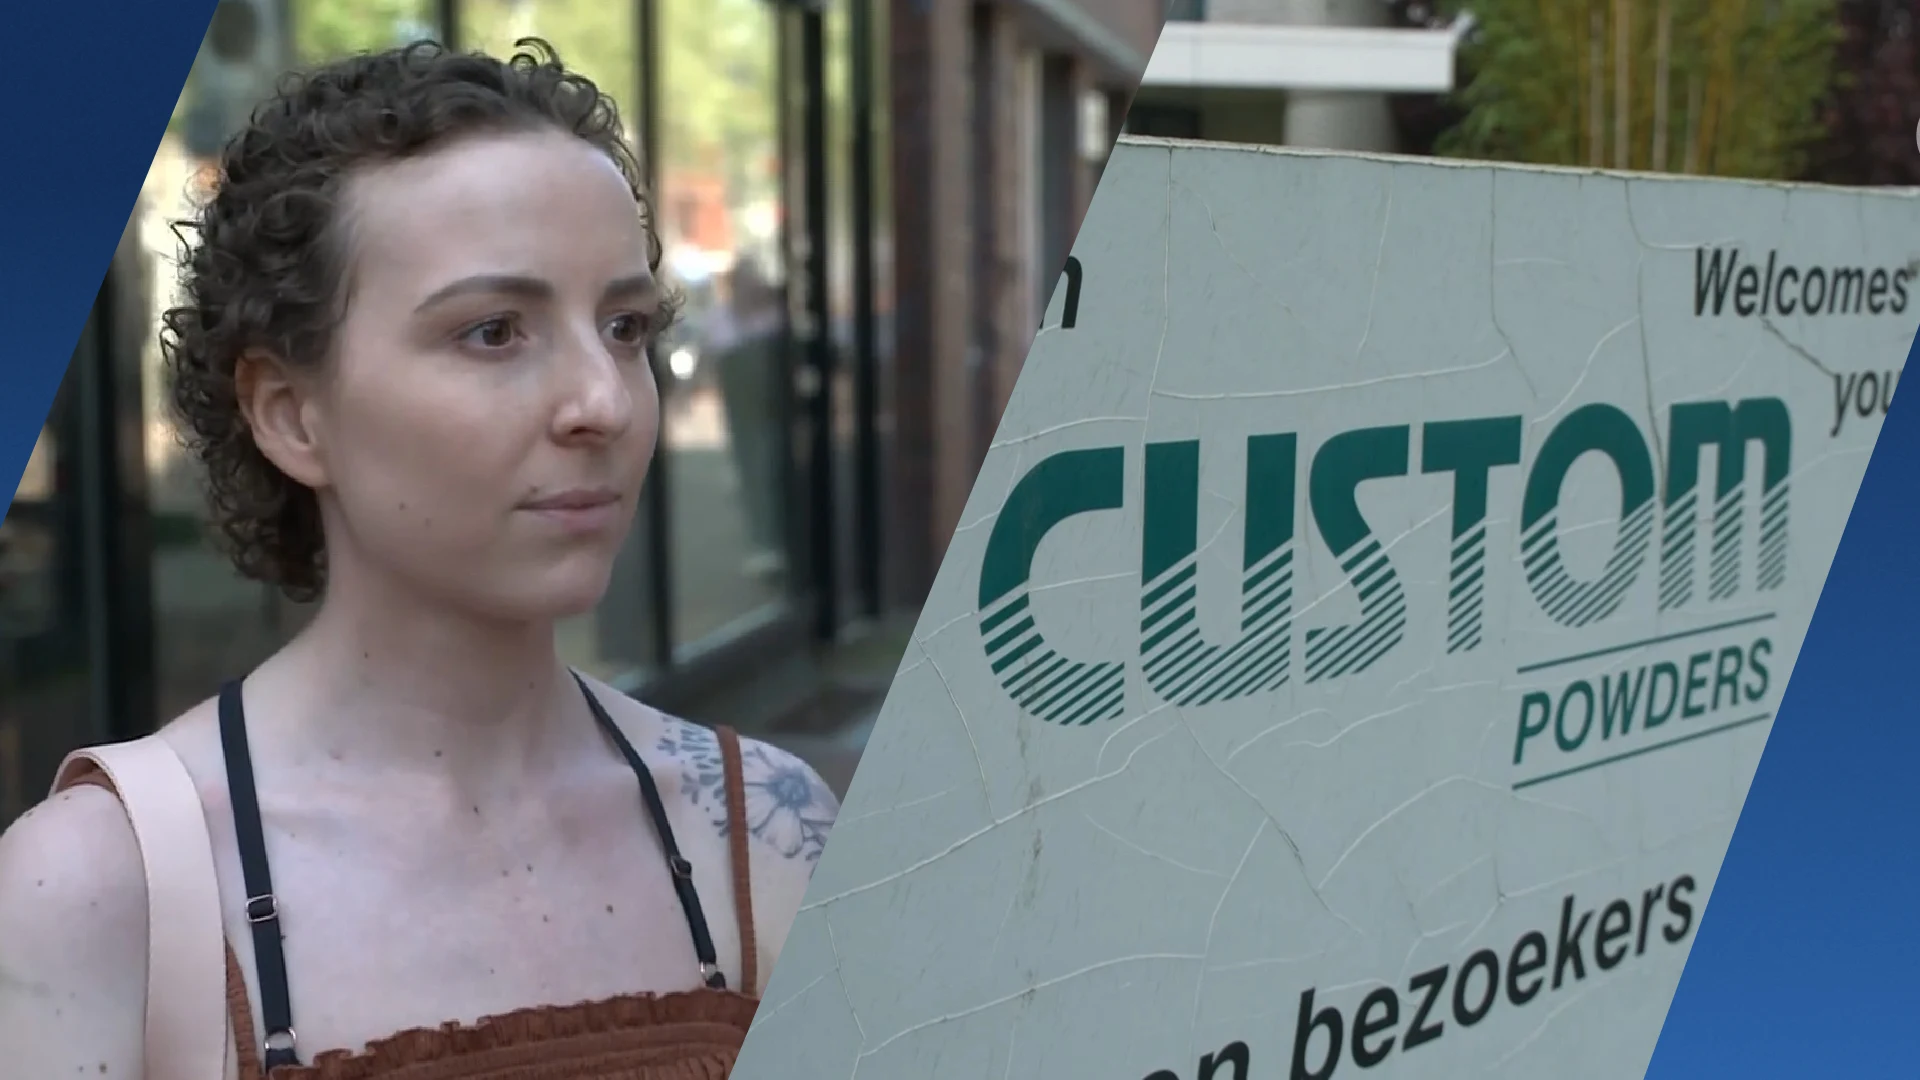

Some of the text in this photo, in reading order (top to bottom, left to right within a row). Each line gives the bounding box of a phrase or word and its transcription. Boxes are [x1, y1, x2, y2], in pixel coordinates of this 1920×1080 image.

[1694, 247, 1909, 317] Welcomes
[979, 396, 1793, 727] CUSTOM
[1513, 637, 1773, 766] POWDERS
[1290, 874, 1696, 1080] bezoekers
